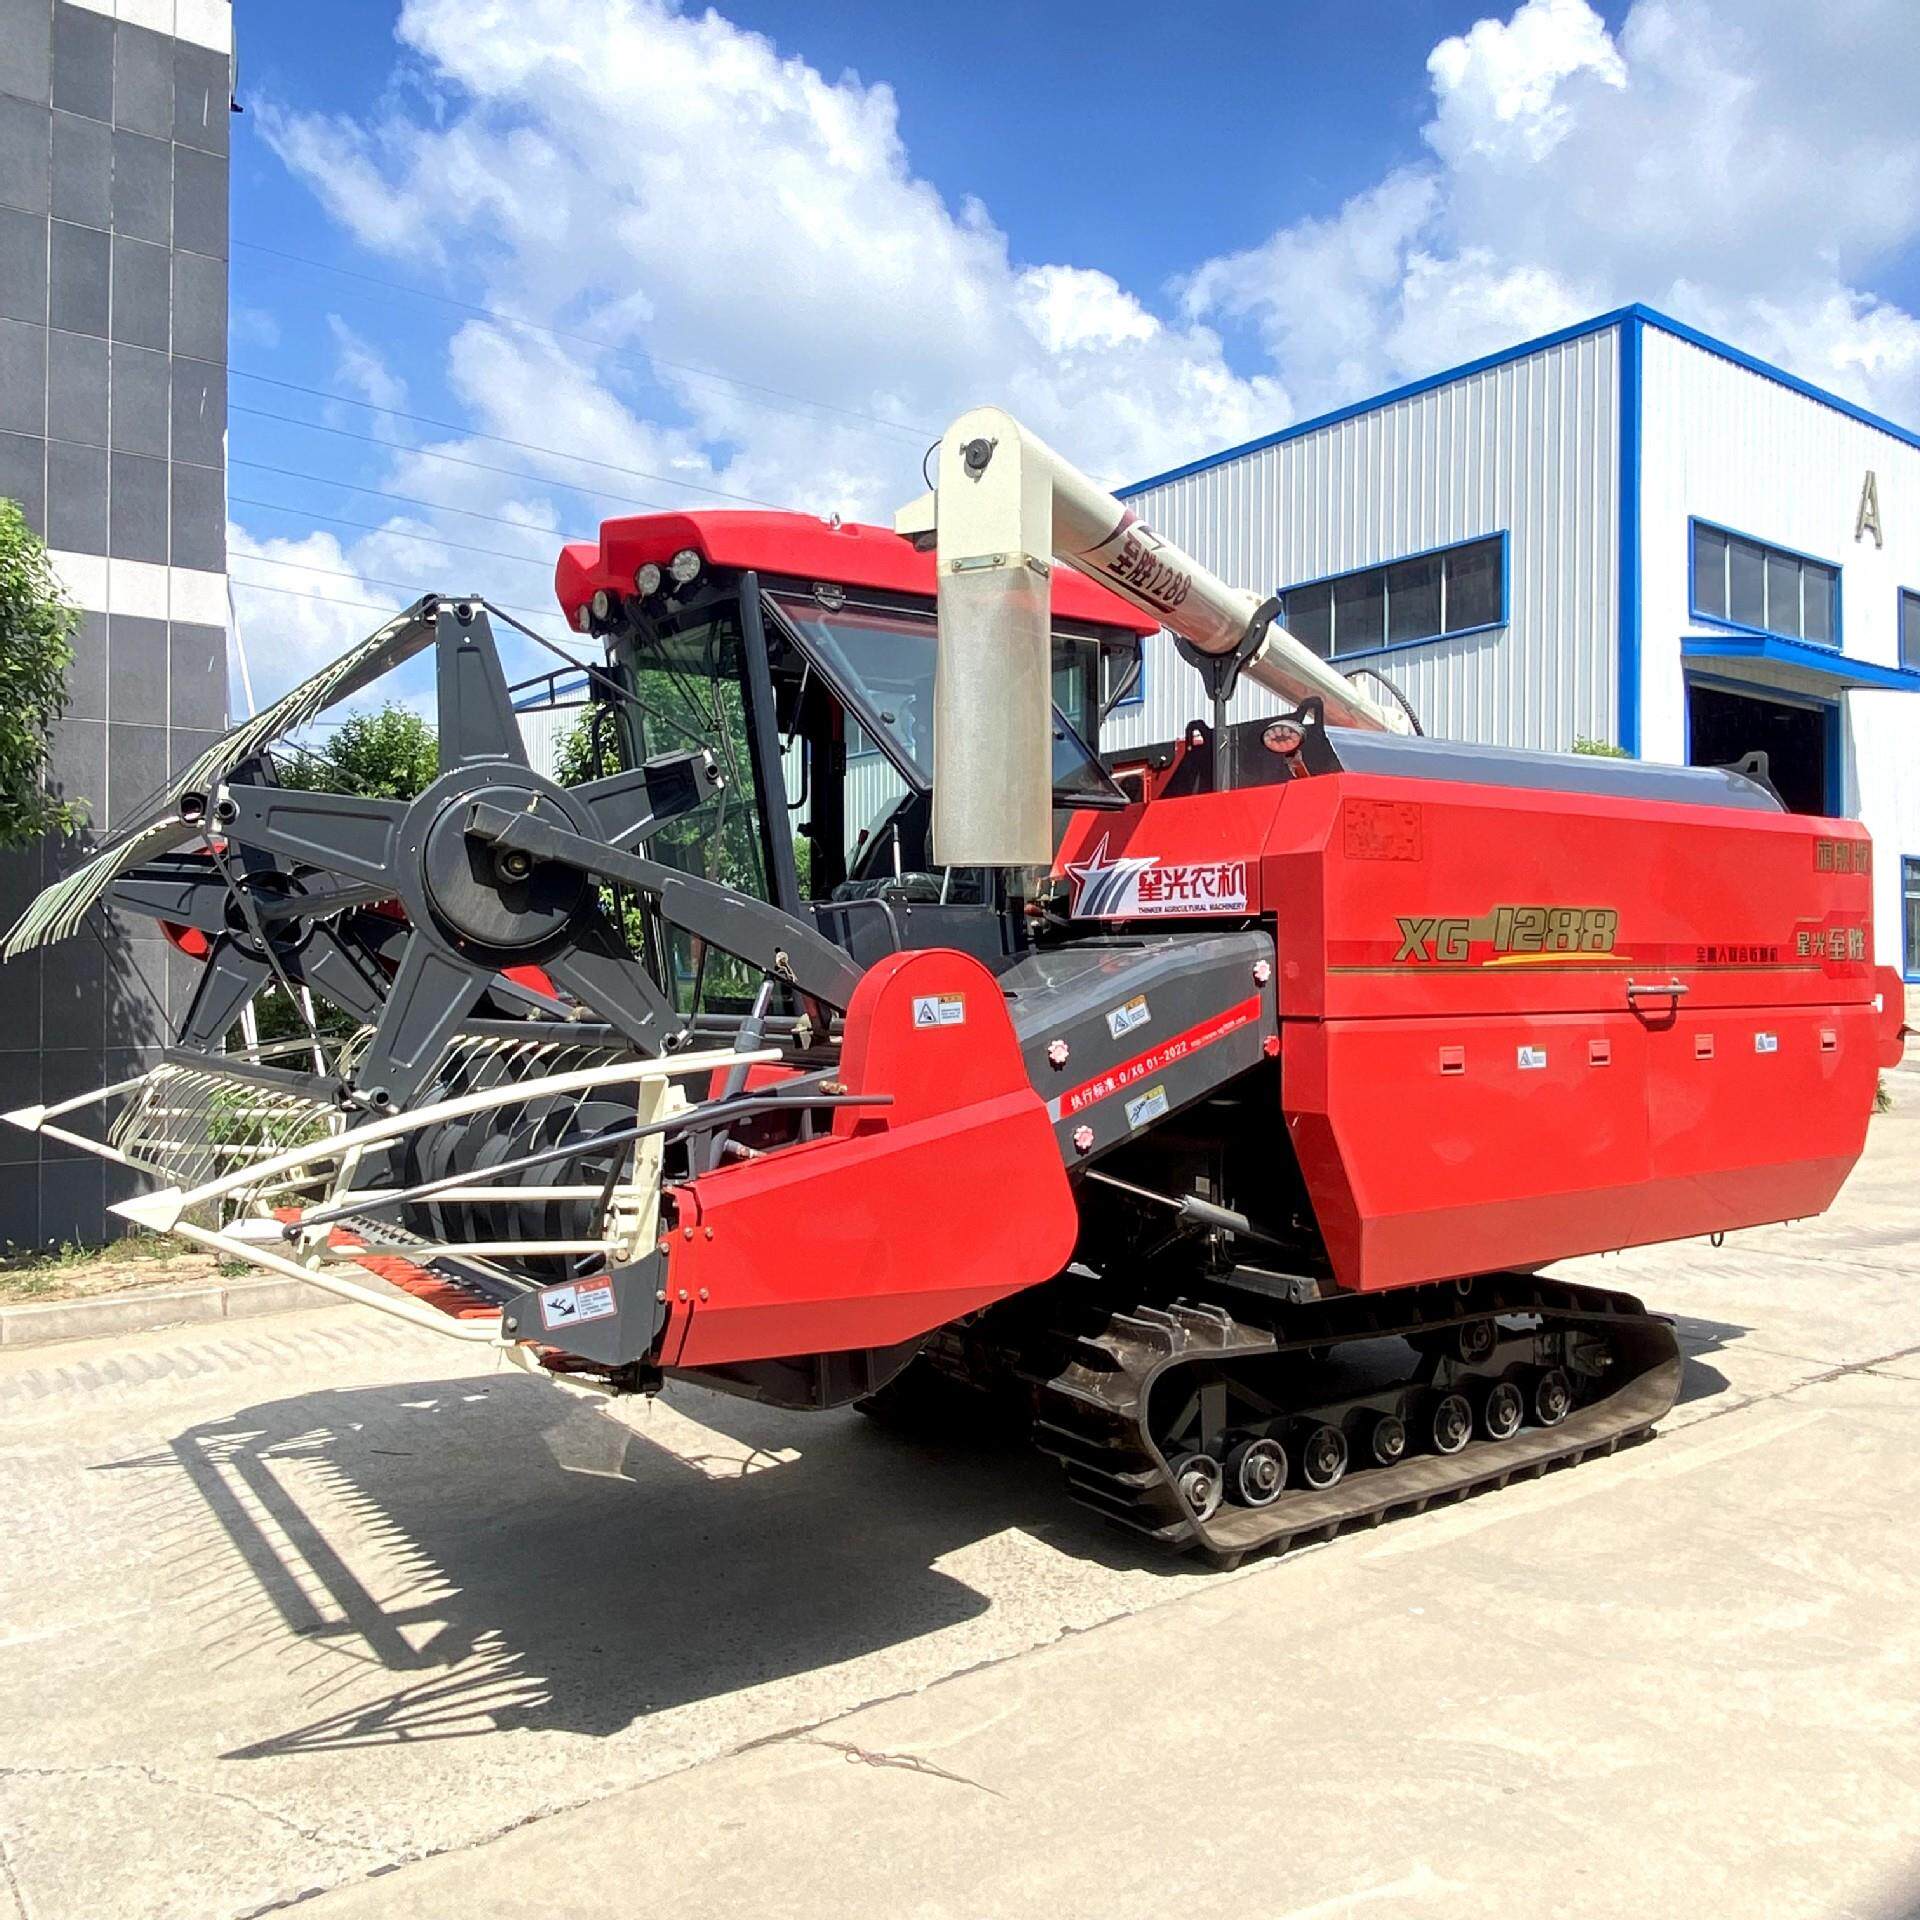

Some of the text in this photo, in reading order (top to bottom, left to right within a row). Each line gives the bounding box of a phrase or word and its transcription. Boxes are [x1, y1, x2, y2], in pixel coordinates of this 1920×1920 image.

[1855, 470, 1882, 550] A
[1138, 863, 1245, 902] 星光农机
[1138, 902, 1245, 914] THINKER AGRICULTURAL MACHINERY
[1392, 907, 1618, 962] XG 1288
[1146, 1040, 1188, 1070] 01-2022
